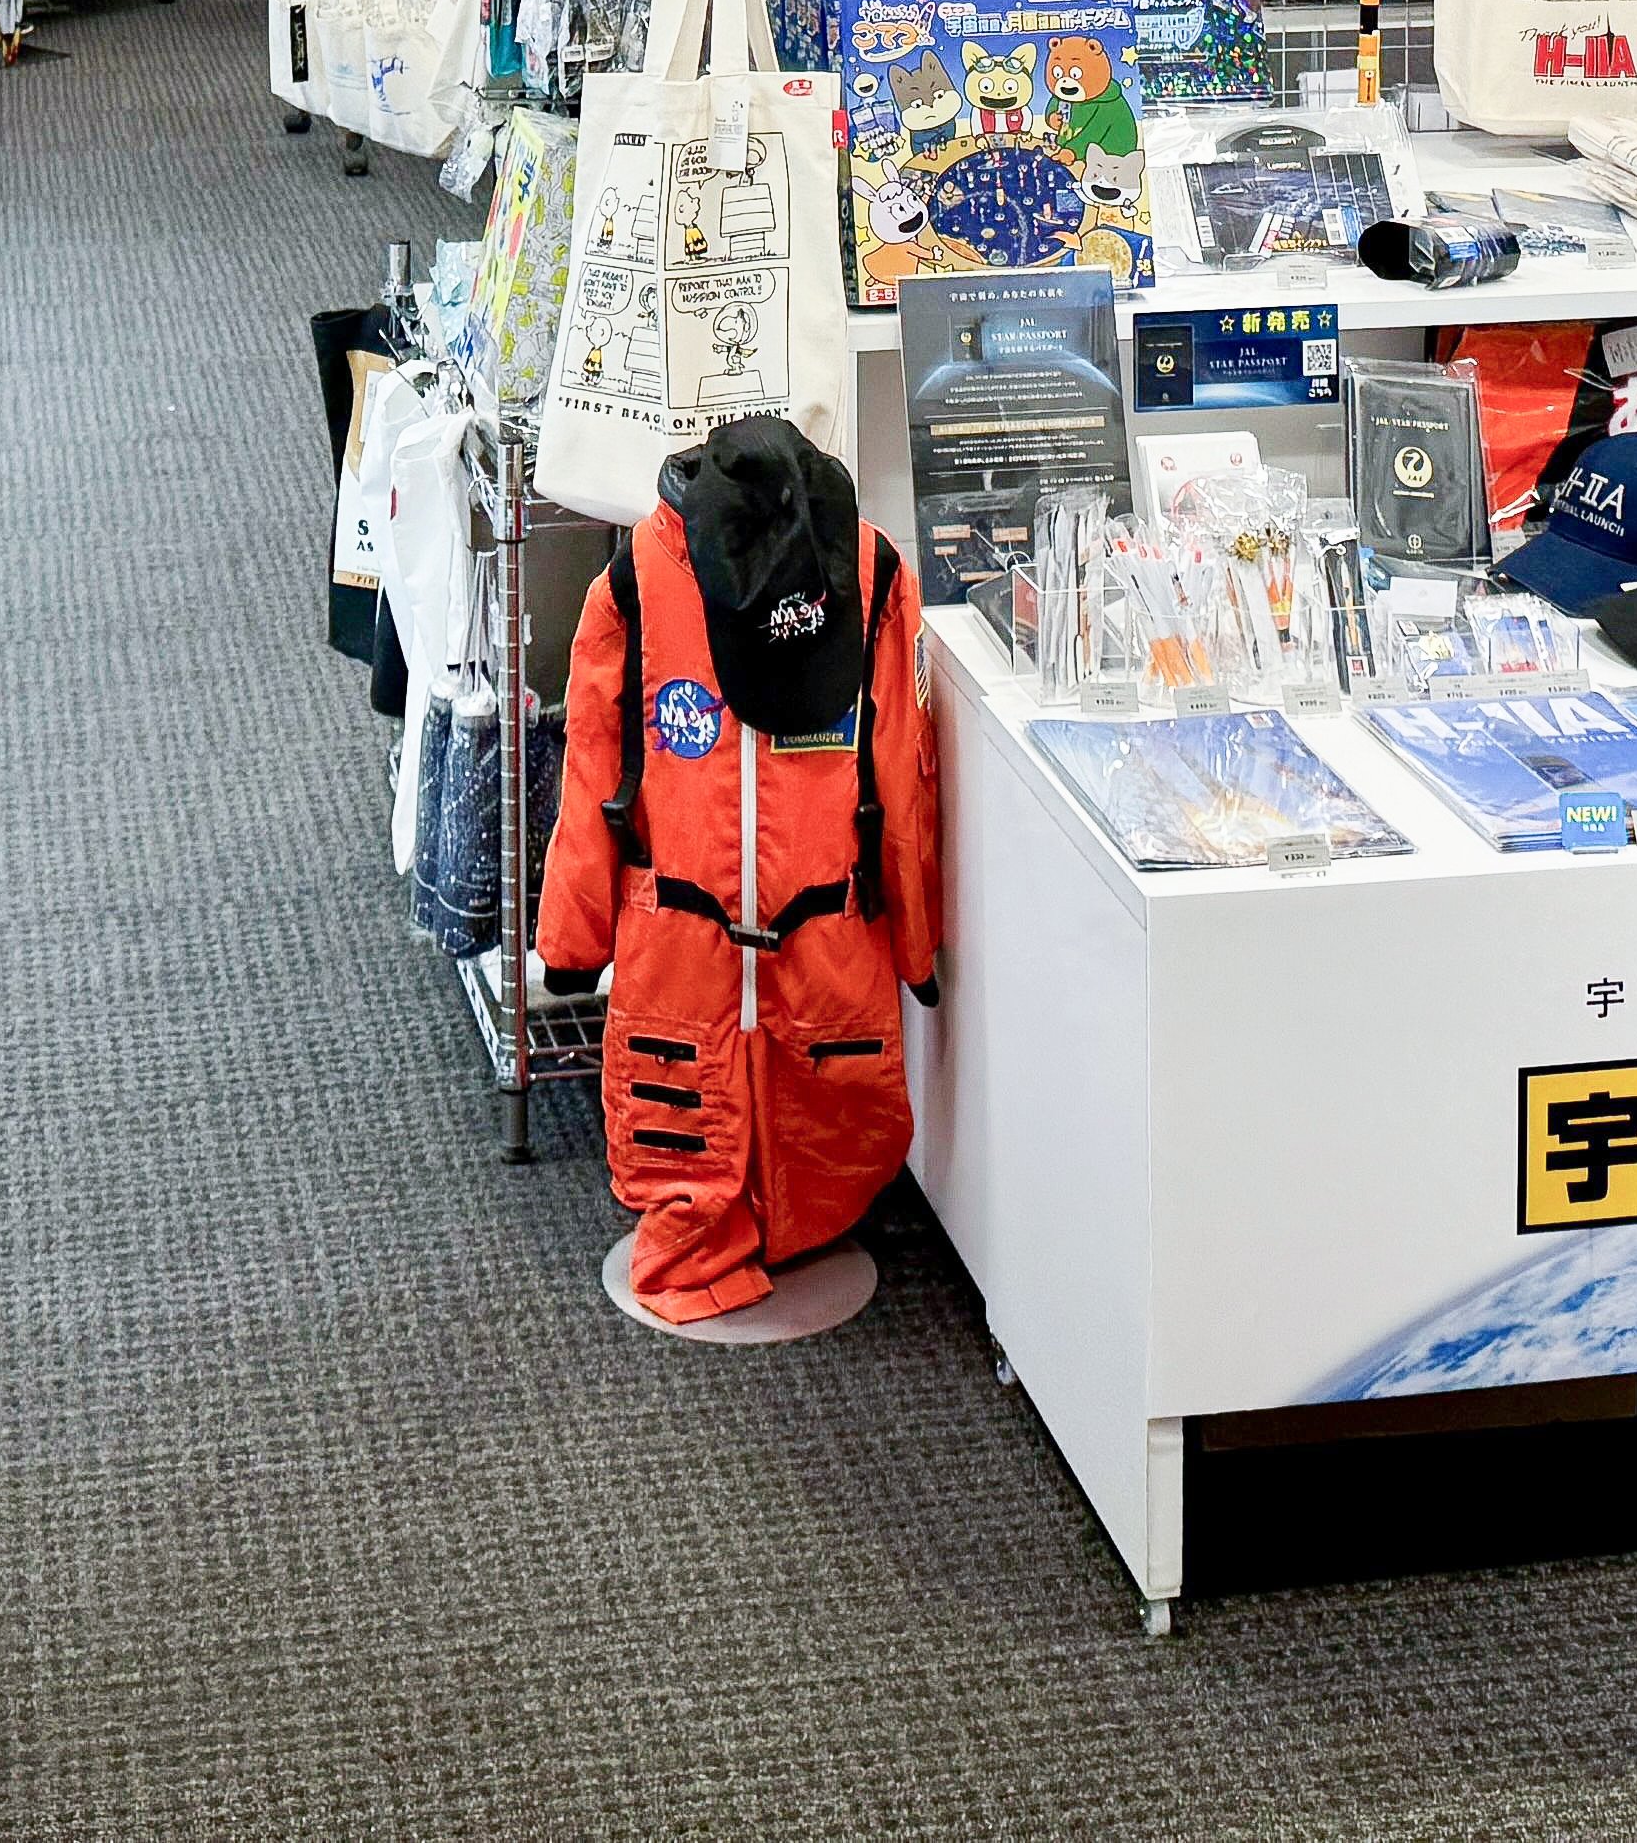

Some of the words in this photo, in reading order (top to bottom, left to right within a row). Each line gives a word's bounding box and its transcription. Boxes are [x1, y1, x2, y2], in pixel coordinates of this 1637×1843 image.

[1534, 34, 1637, 78] H-IIA
[1243, 310, 1311, 334] 新発売
[1239, 347, 1256, 357] JAL
[673, 416, 697, 428] ON
[1580, 509, 1625, 537] LAUNCH
[1566, 805, 1617, 823] NEW!
